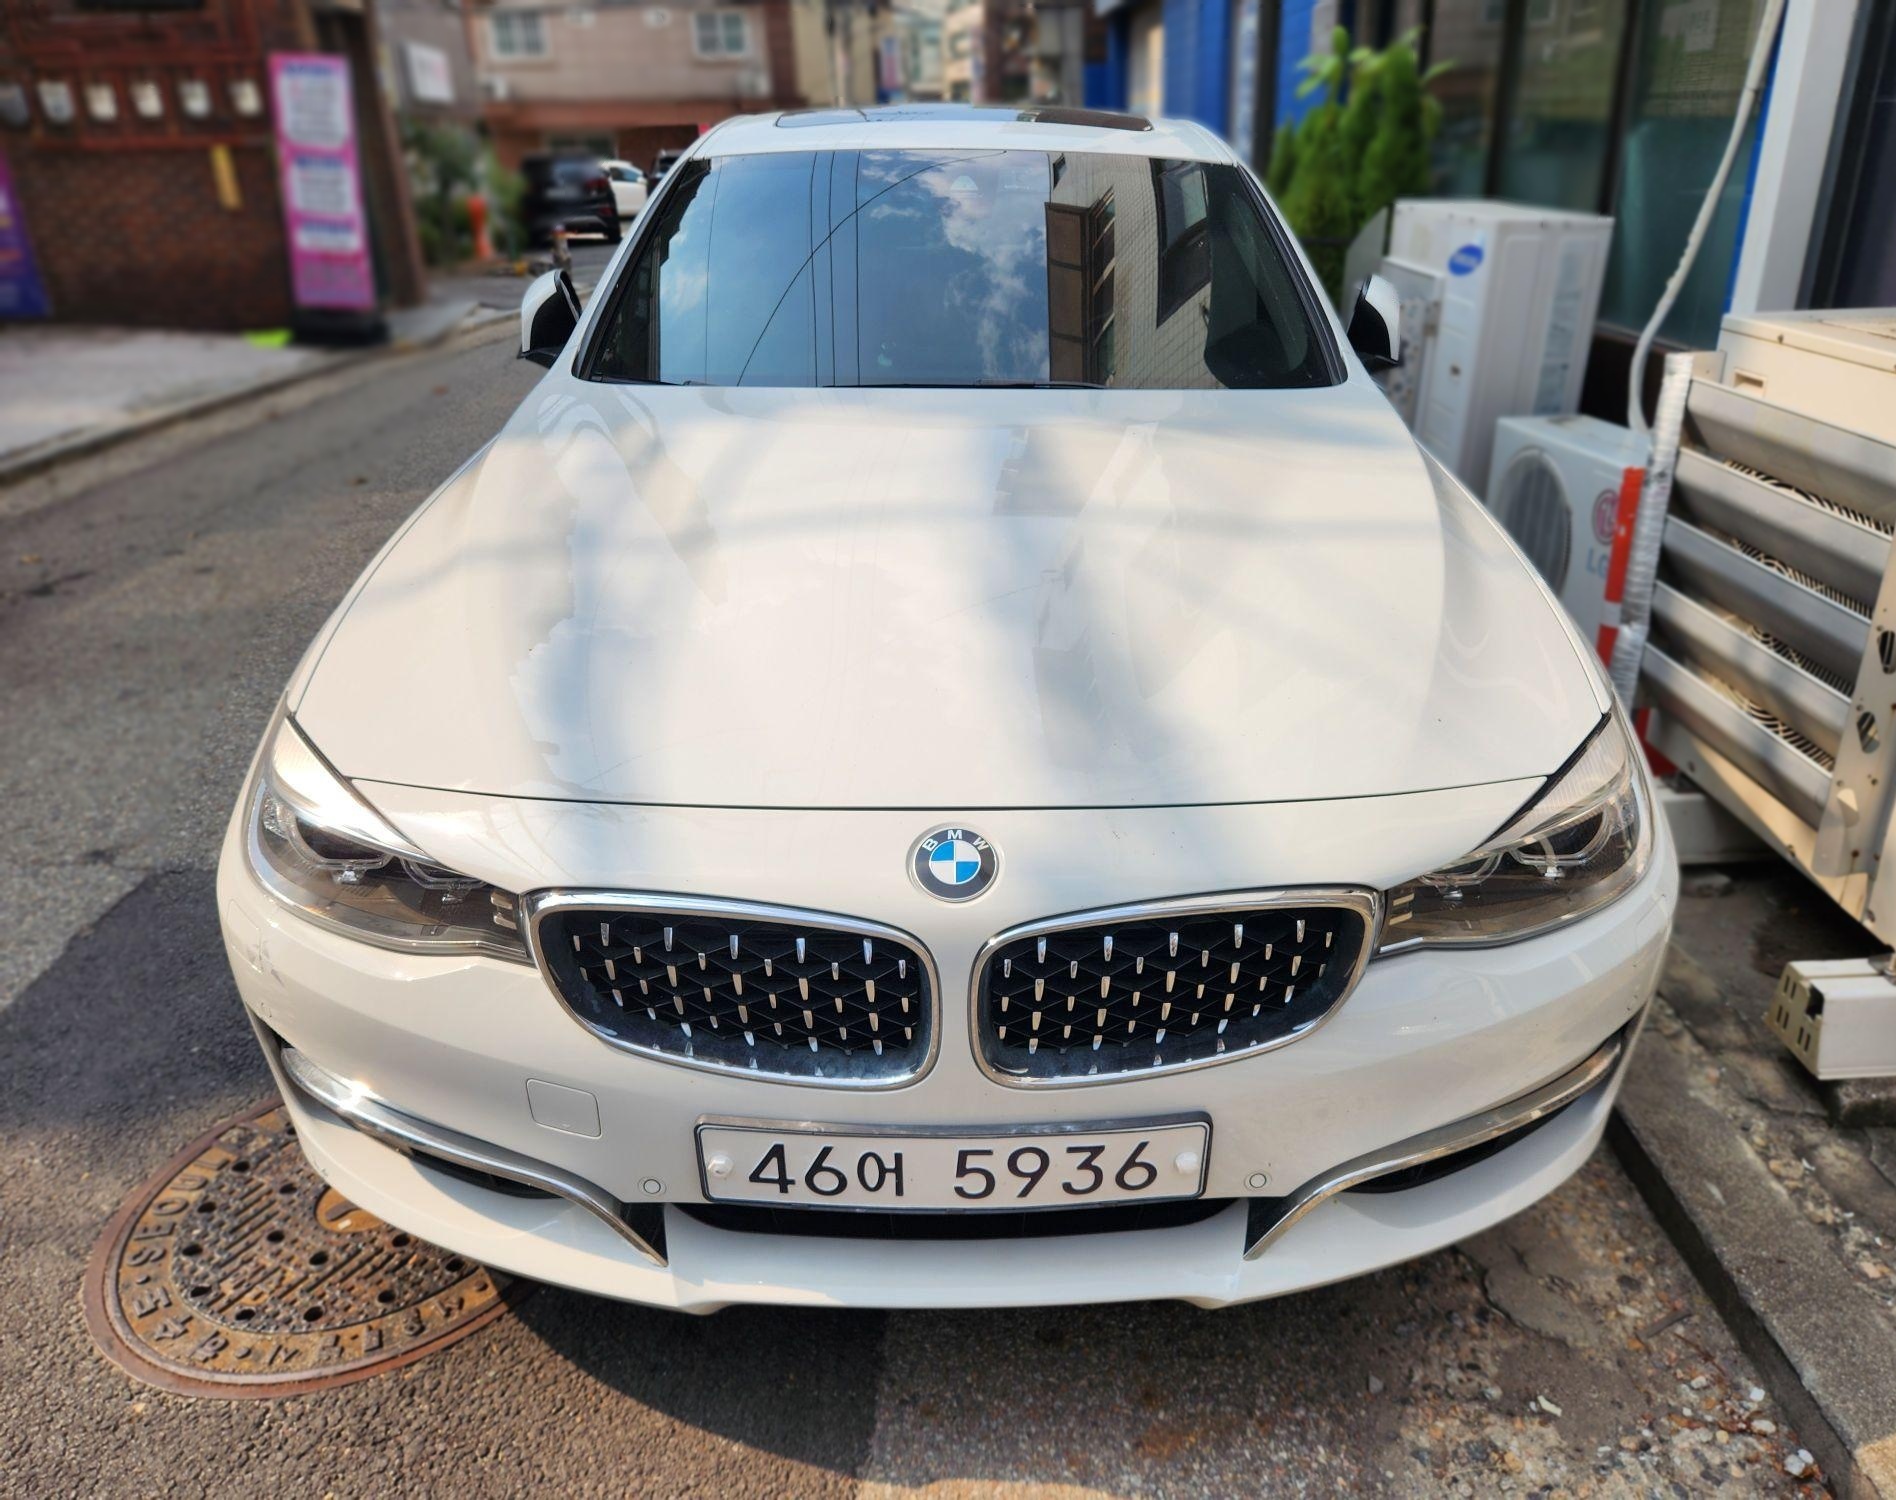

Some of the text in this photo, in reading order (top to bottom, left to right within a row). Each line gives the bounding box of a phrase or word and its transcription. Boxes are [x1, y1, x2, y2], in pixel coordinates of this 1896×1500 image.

[921, 829, 989, 852] BMW
[748, 1140, 1159, 1199] 46어 5936
[126, 1156, 230, 1267] SEOUL
